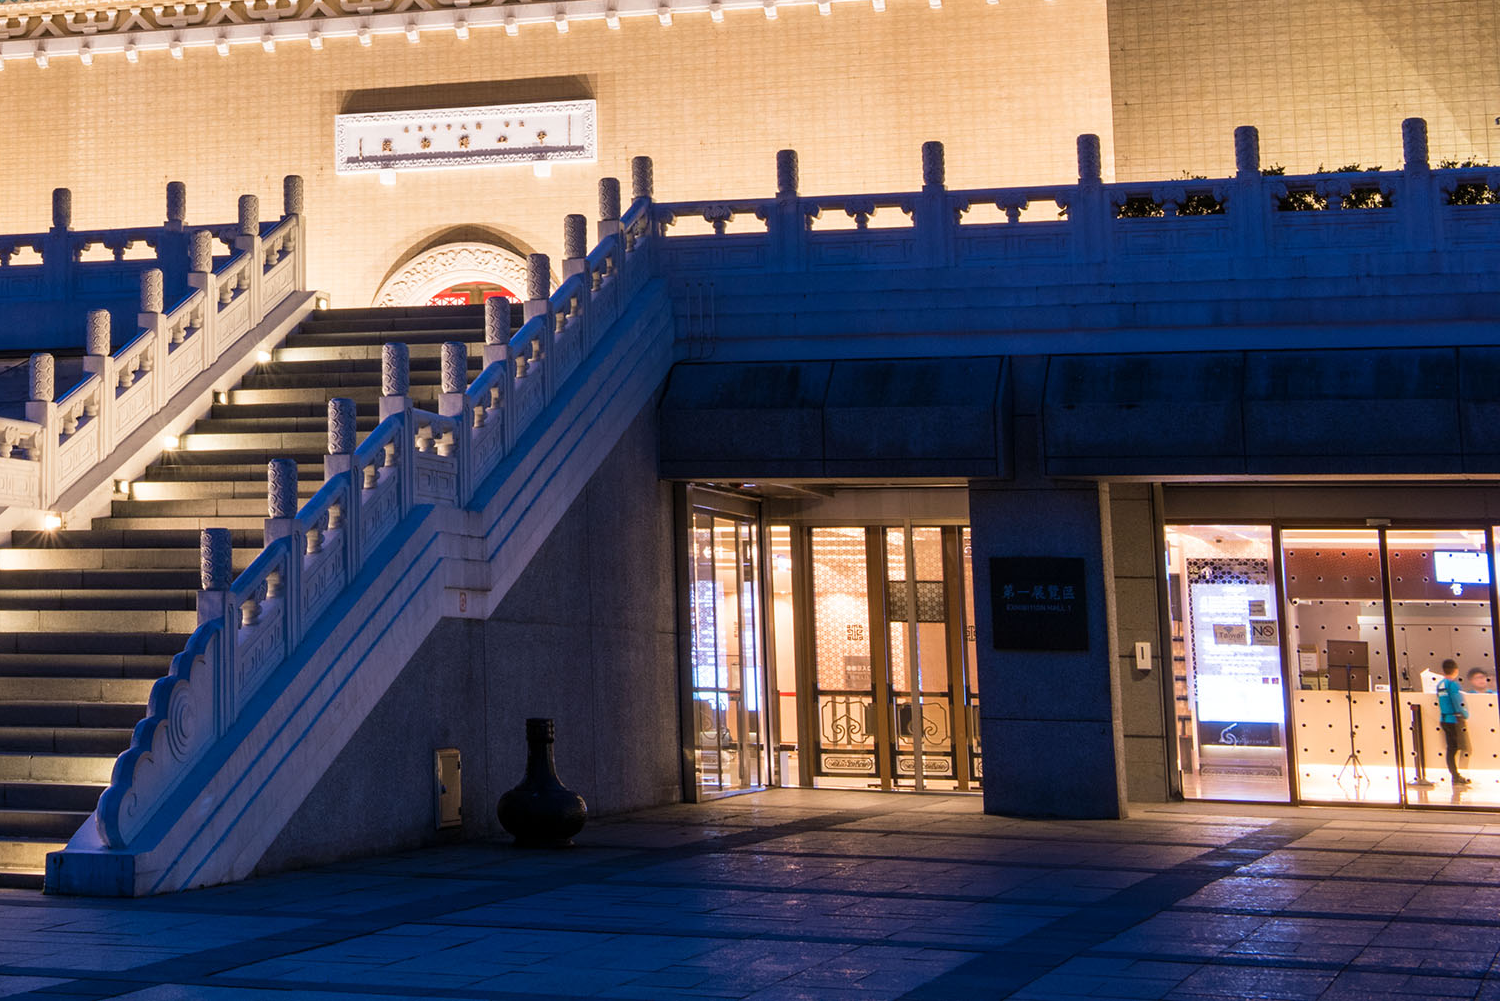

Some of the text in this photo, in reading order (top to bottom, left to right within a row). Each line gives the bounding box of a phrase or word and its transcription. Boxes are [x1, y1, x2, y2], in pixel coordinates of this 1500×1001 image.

[1003, 584, 1076, 600] 第一展覽區
